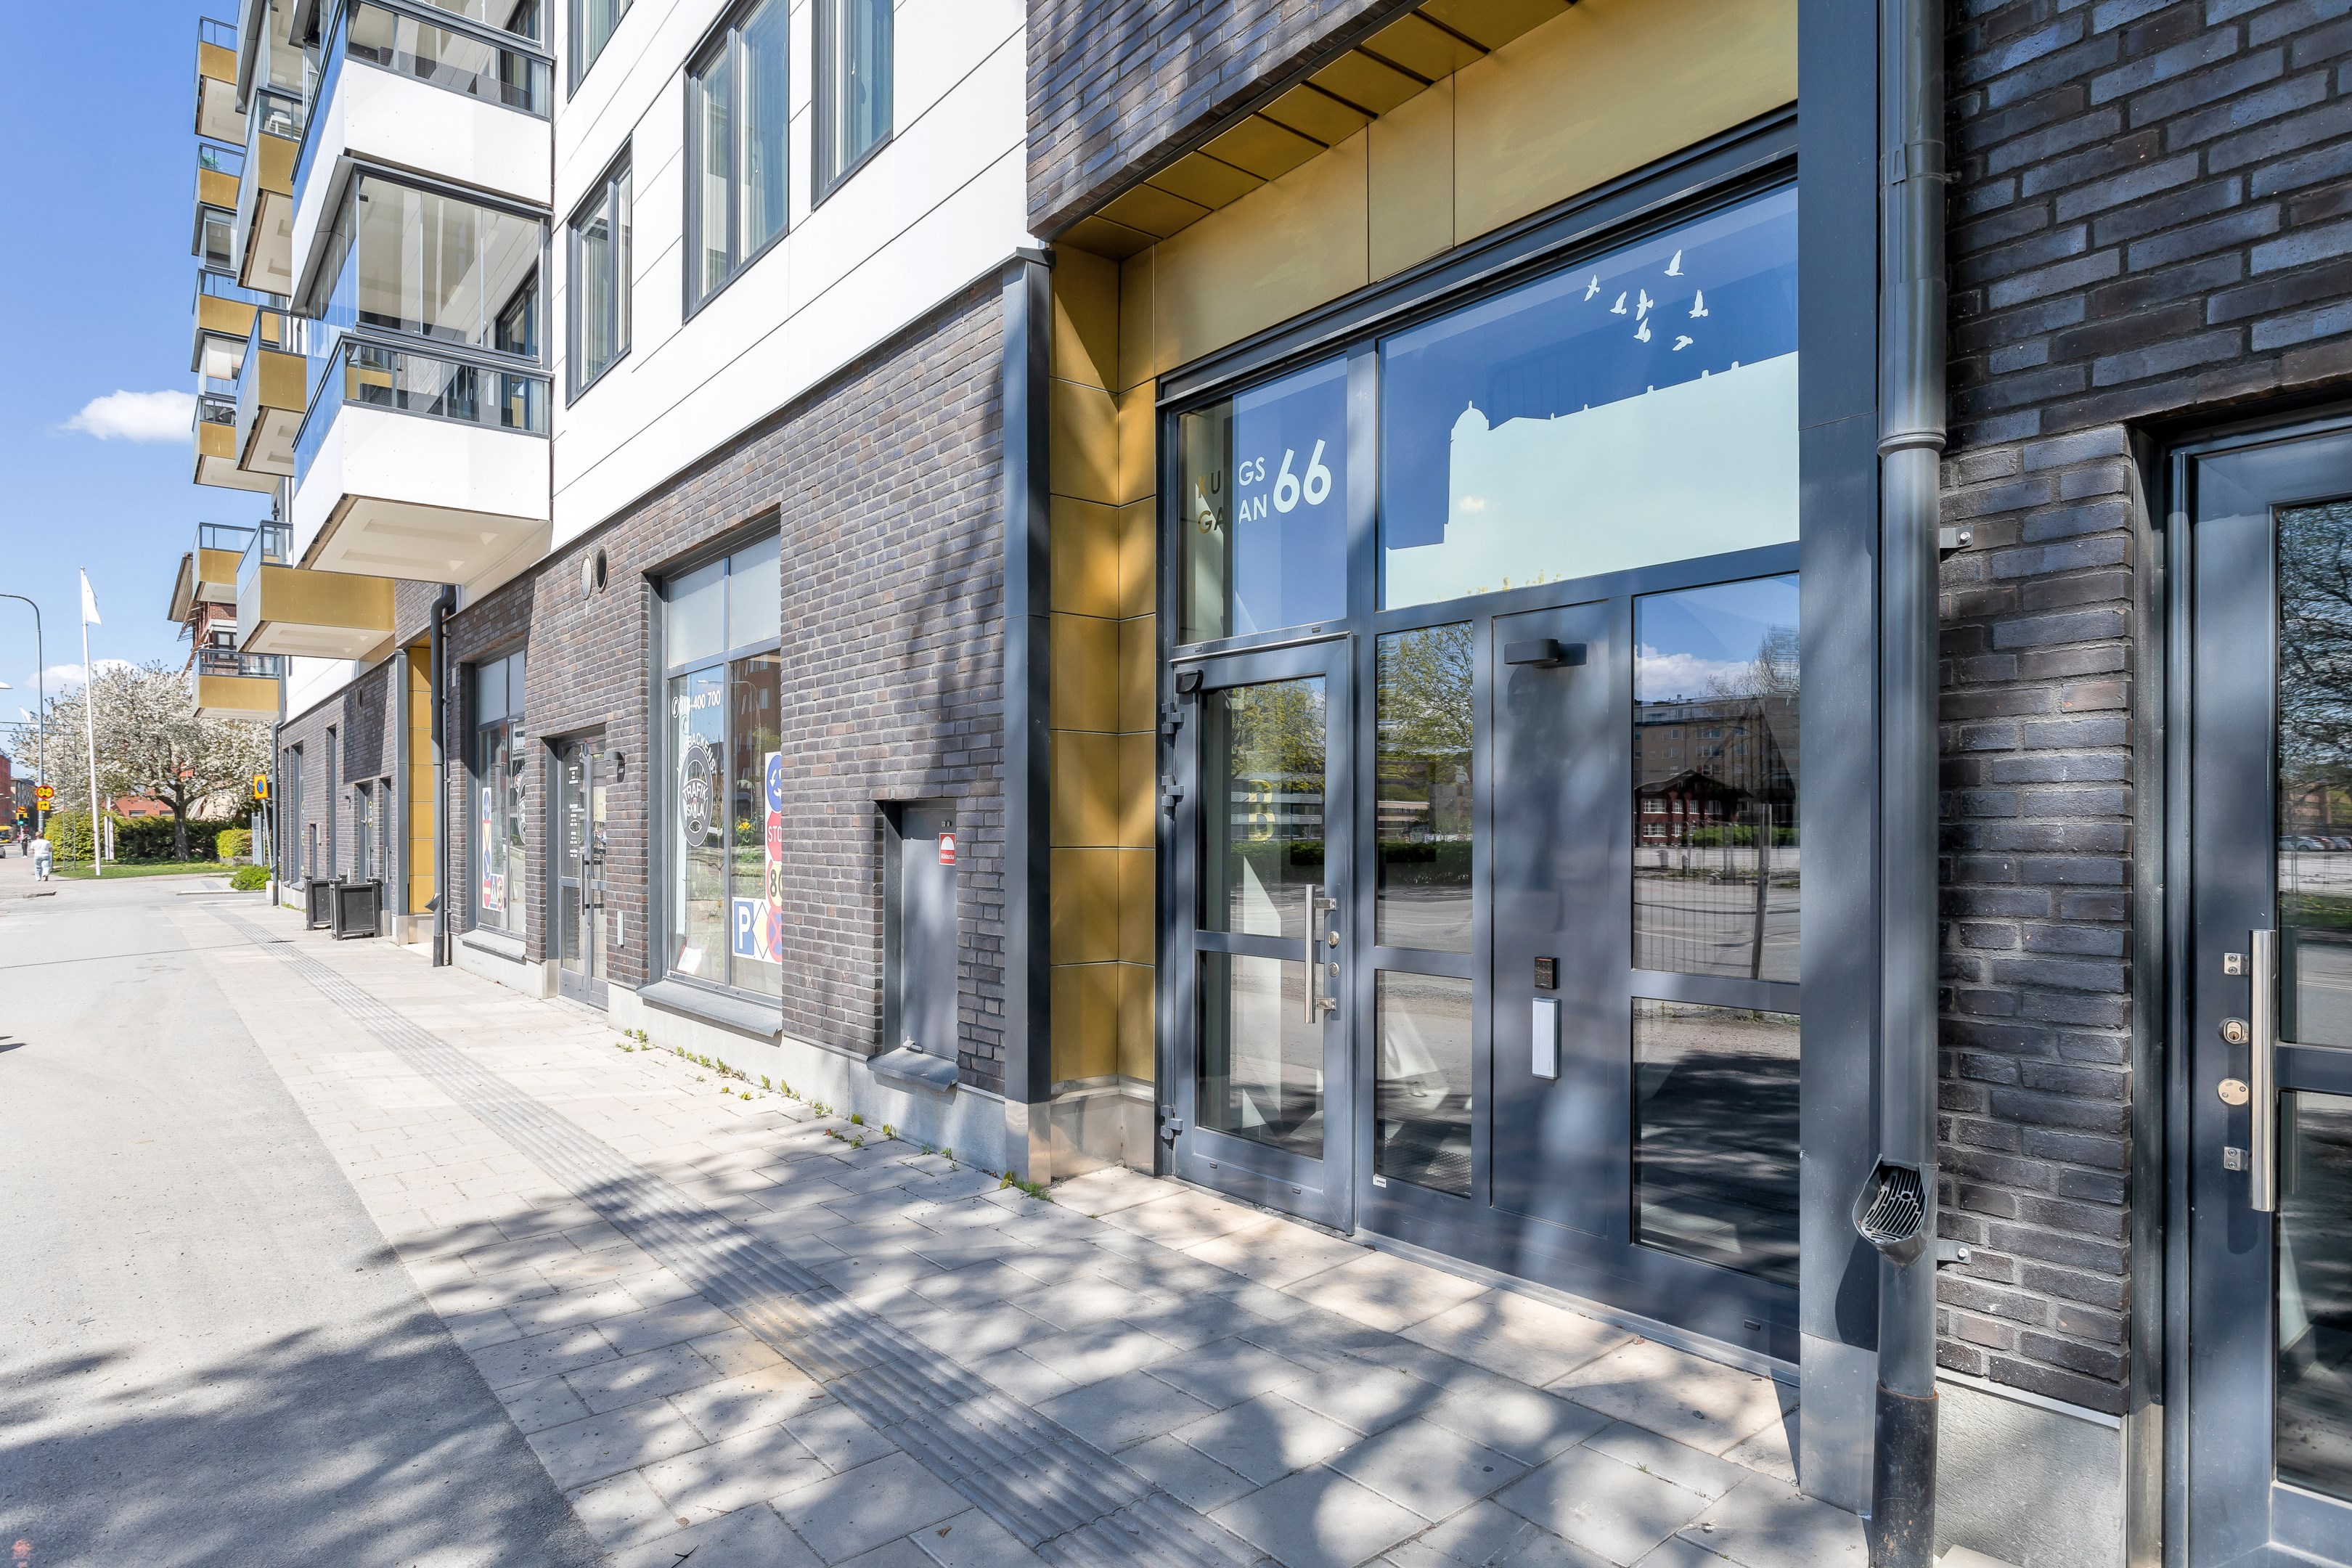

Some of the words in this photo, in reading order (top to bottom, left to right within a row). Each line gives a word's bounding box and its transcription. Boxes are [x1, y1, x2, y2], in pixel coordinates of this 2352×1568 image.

[1273, 438, 1332, 514] 66
[707, 690, 721, 708] 700
[682, 781, 709, 801] TRAFIK
[1249, 779, 1276, 841] B
[738, 905, 751, 950] P
